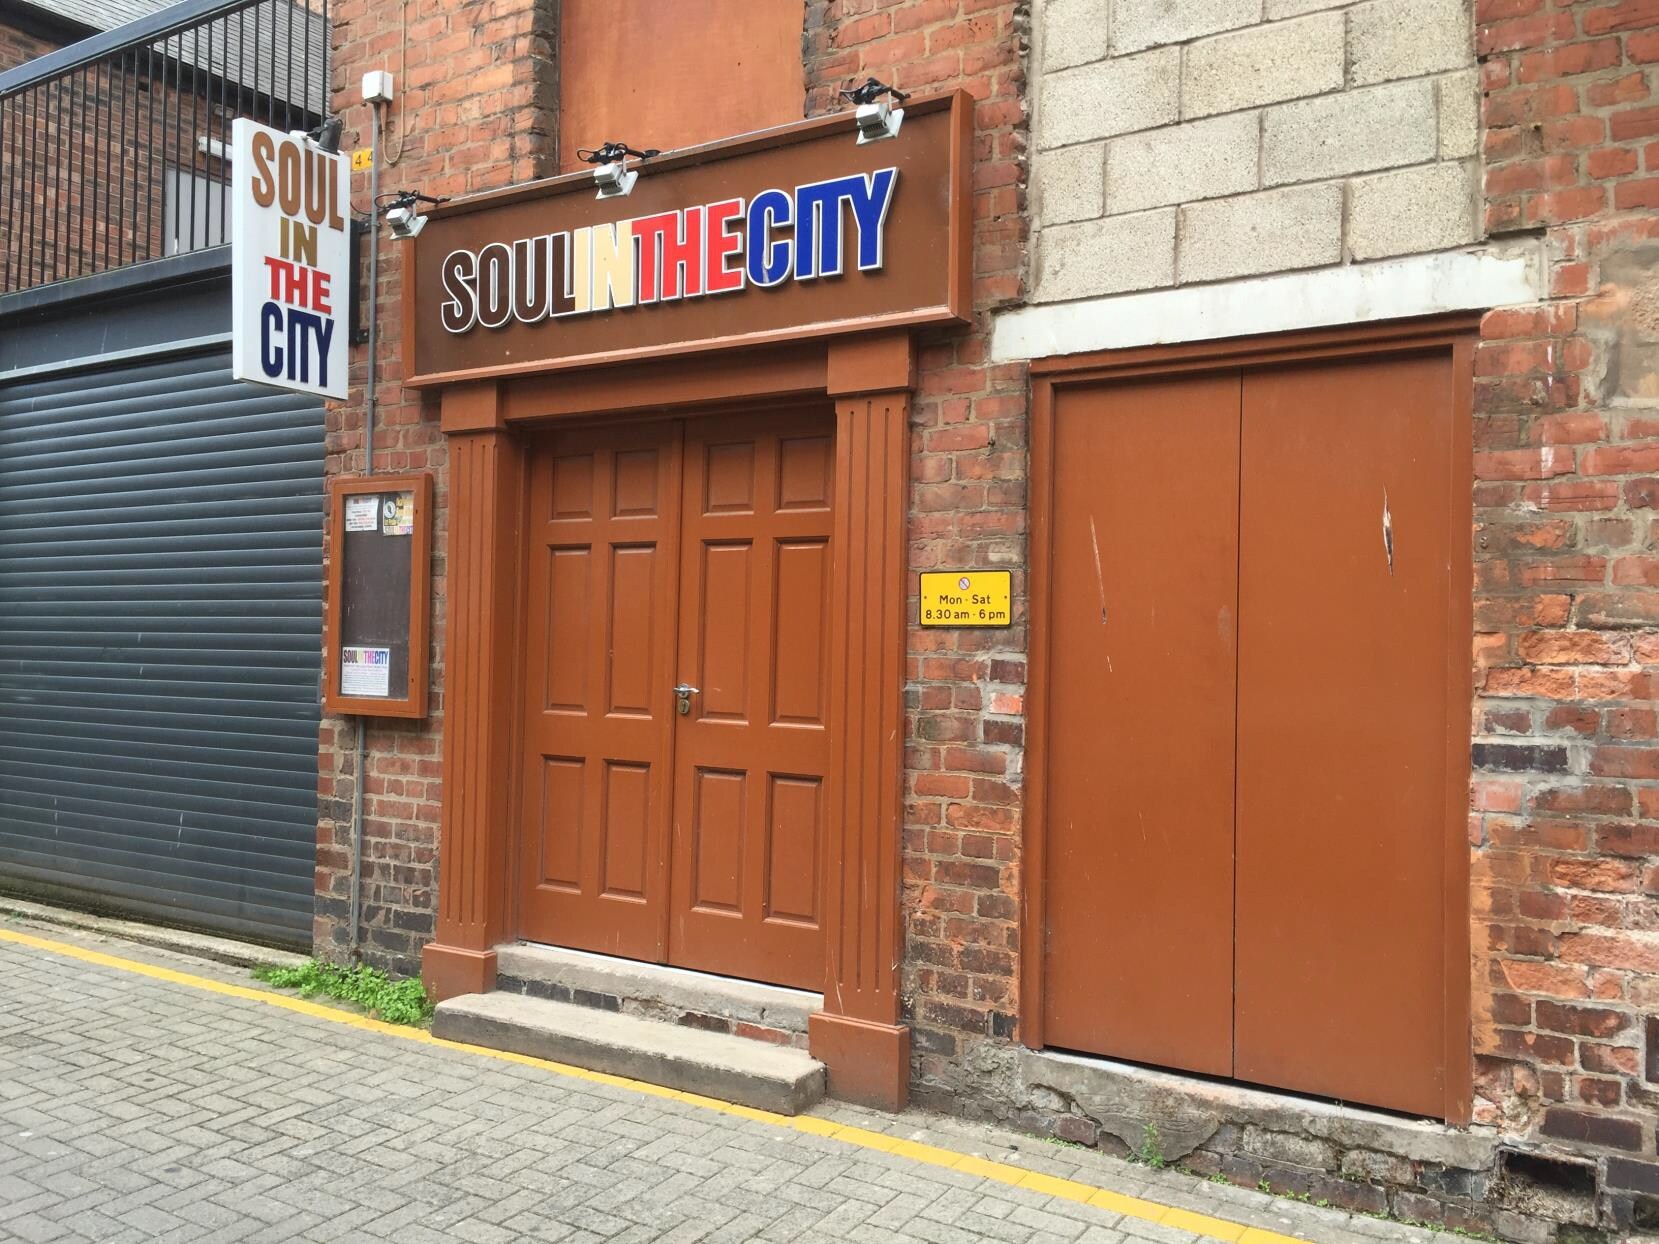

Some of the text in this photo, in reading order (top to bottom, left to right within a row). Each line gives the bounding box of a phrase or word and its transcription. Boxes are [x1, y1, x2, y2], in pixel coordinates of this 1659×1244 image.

[252, 131, 344, 232] SOUL
[279, 216, 318, 268] IN
[264, 255, 332, 315] THE
[260, 301, 335, 388] CITY
[925, 609, 951, 620] 8.30
[954, 611, 970, 619] am
[979, 609, 986, 619] 6
[988, 611, 1005, 621] pm
[939, 595, 962, 605] Mon
[972, 594, 991, 604] Sat
